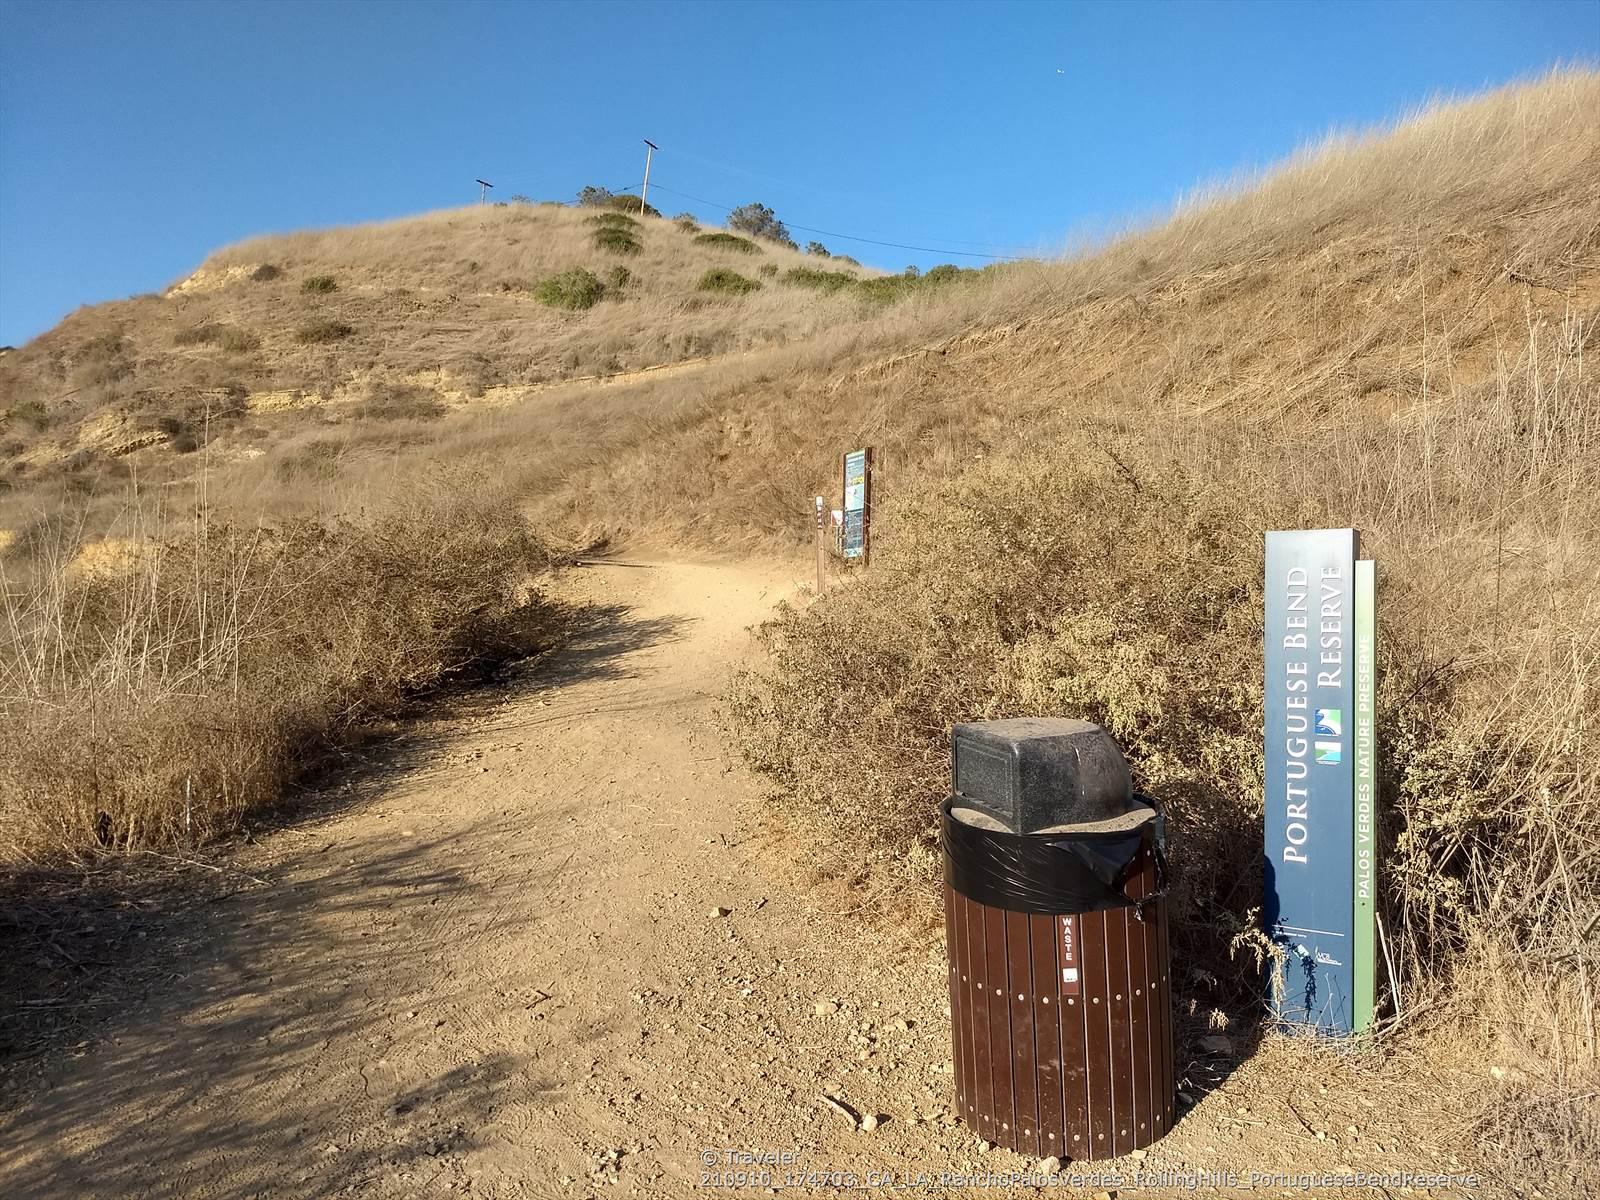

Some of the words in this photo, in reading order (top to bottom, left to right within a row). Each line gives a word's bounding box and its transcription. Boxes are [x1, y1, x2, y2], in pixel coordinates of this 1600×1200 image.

[1283, 566, 1309, 651] BEND
[1317, 566, 1343, 689] RESERVE
[1358, 633, 1371, 713] PRESERVE
[1283, 661, 1309, 865] PORTUGUESE
[1358, 717, 1370, 778] NATURE
[1358, 783, 1370, 844] VERDES
[1358, 848, 1370, 899] PALOS
[1062, 917, 1074, 961] WASTE
